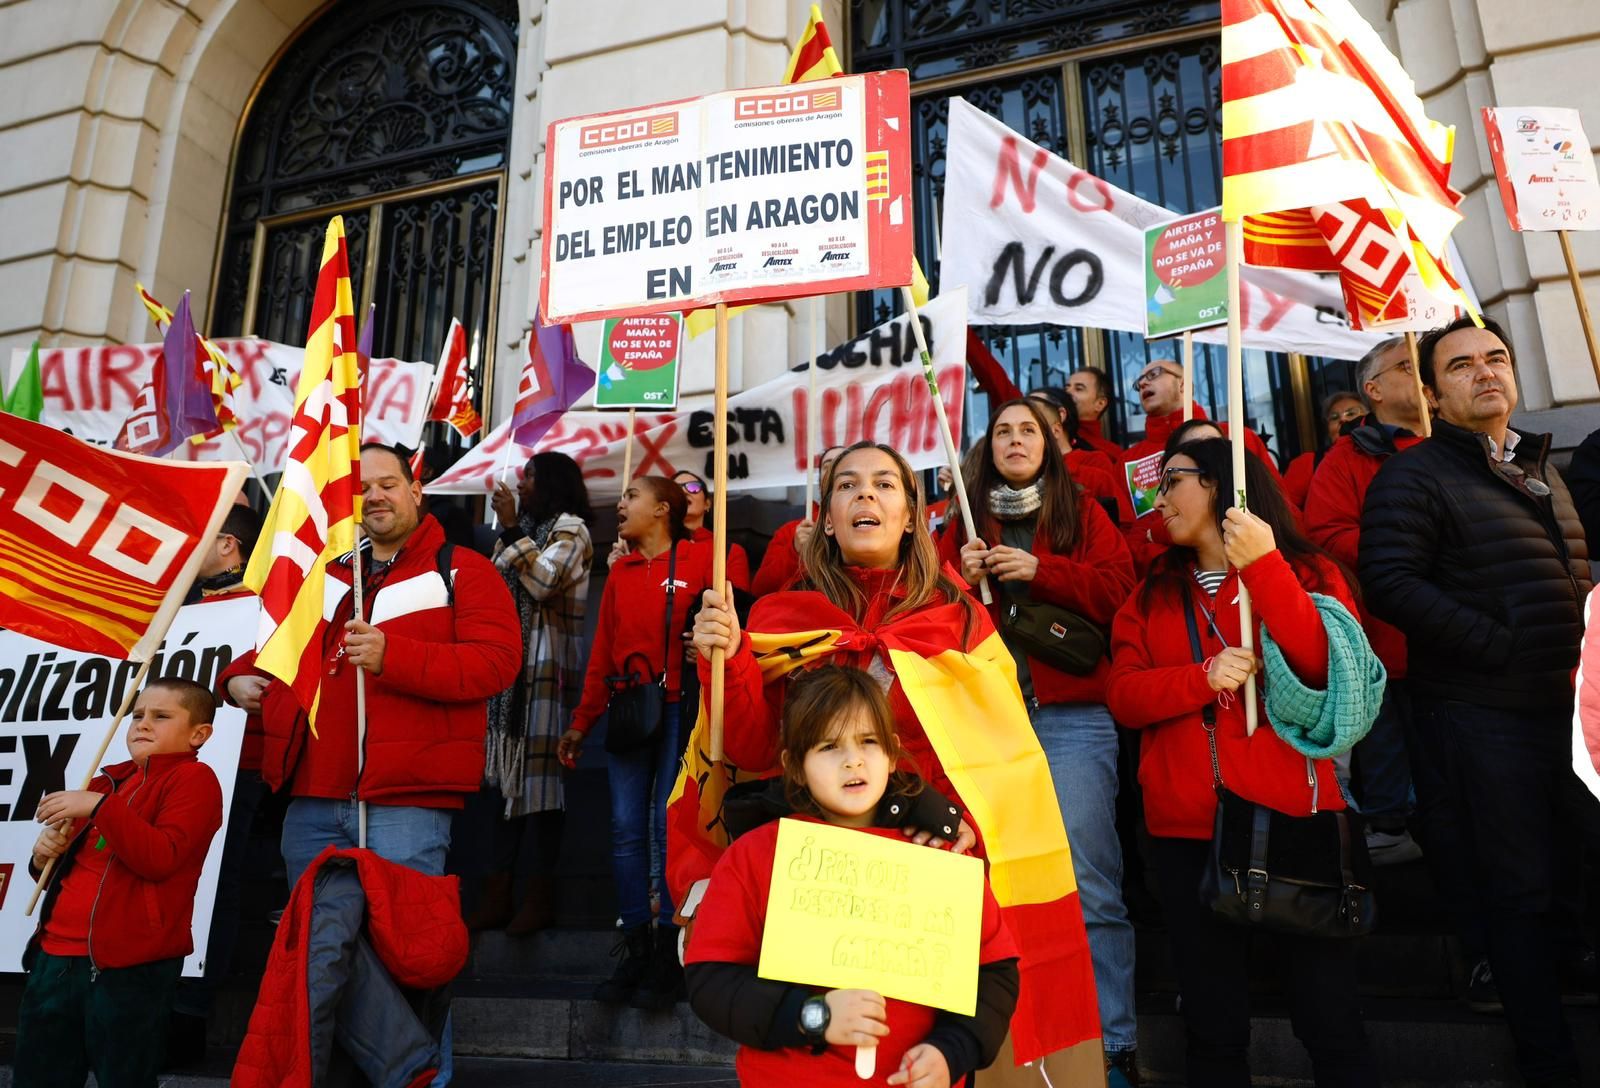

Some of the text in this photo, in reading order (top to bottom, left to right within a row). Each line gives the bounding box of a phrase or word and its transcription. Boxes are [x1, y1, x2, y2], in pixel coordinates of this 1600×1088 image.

[740, 95, 808, 116] CCOO
[734, 120, 775, 128] comisiones
[776, 116, 804, 125] obreras
[816, 112, 842, 120] Aragón
[584, 120, 648, 144] CCOO
[578, 147, 616, 158] comisiones
[618, 143, 643, 152] obreras
[654, 137, 679, 146] Aragón
[560, 138, 853, 210] POR EL MANTENIMIENTO
[556, 190, 860, 262] DEL EMPLEO EN ARAGON
[1164, 216, 1217, 239] AIRTEX ES
[1169, 231, 1213, 250] MAÑA Y
[763, 257, 792, 268] AIRTEX
[820, 251, 850, 263] AIRTEX
[1156, 242, 1222, 267] NO SE VA DE
[983, 240, 1104, 307] NO
[1170, 258, 1214, 277] ESPAÑA
[646, 265, 692, 300] EN
[622, 317, 670, 326] AIRTEX ES
[626, 328, 657, 336] MAÑA
[612, 340, 628, 348] NO
[630, 340, 642, 348] SE
[659, 340, 672, 348] DE
[624, 350, 663, 359] ESPAÑA
